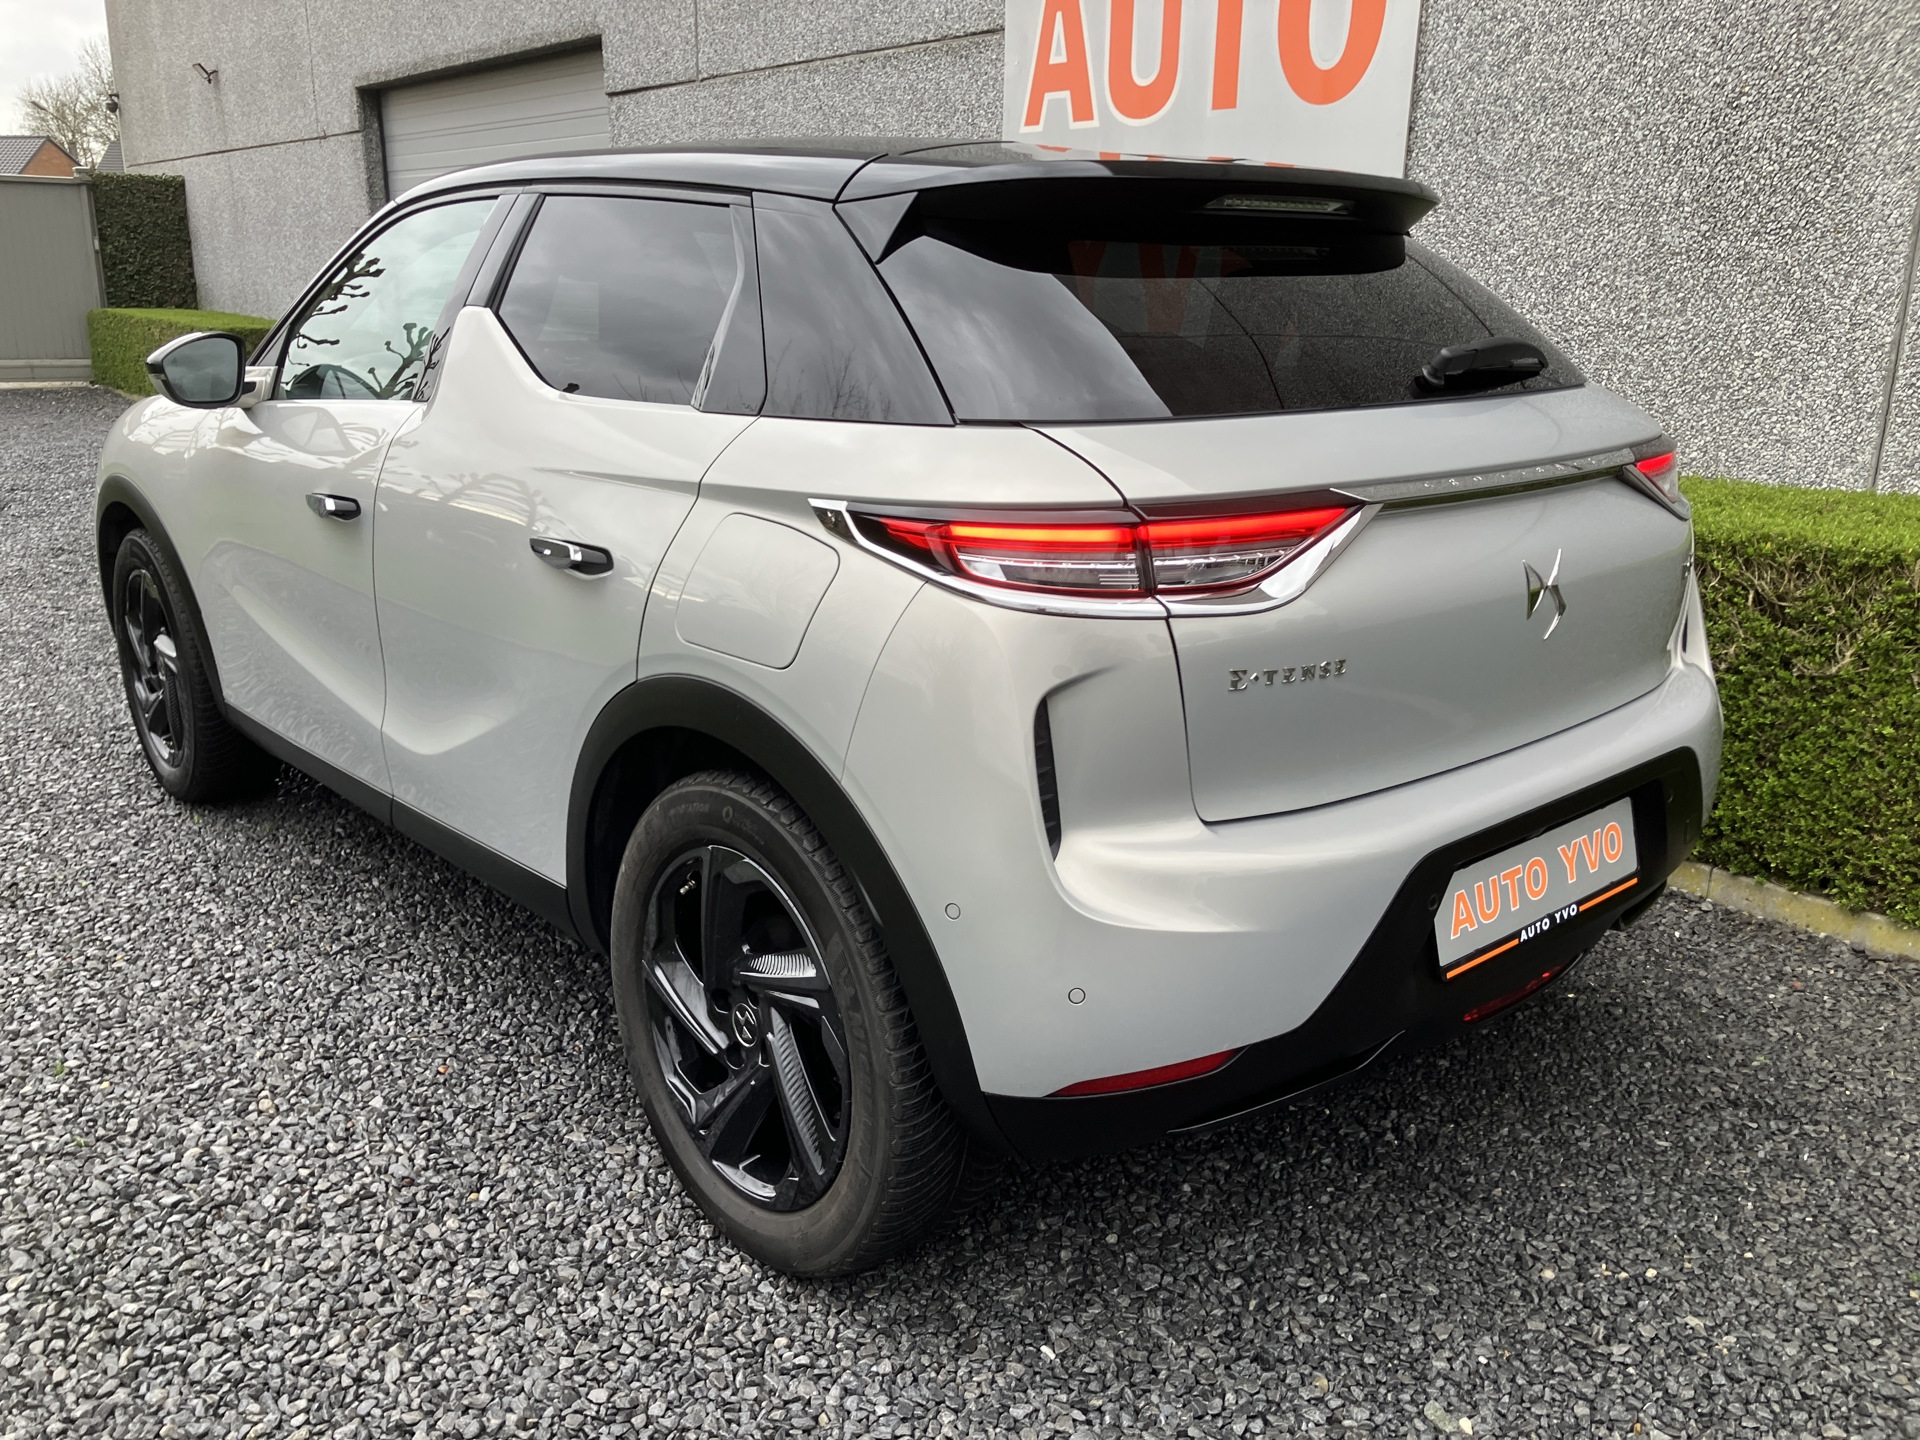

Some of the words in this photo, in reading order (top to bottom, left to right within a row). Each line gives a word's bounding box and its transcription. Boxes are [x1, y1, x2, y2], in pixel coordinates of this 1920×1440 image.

[1451, 857, 1548, 940] AUTO
[1557, 822, 1623, 883] YVO
[1520, 918, 1550, 942] AUTO
[1555, 904, 1578, 924] YVO
